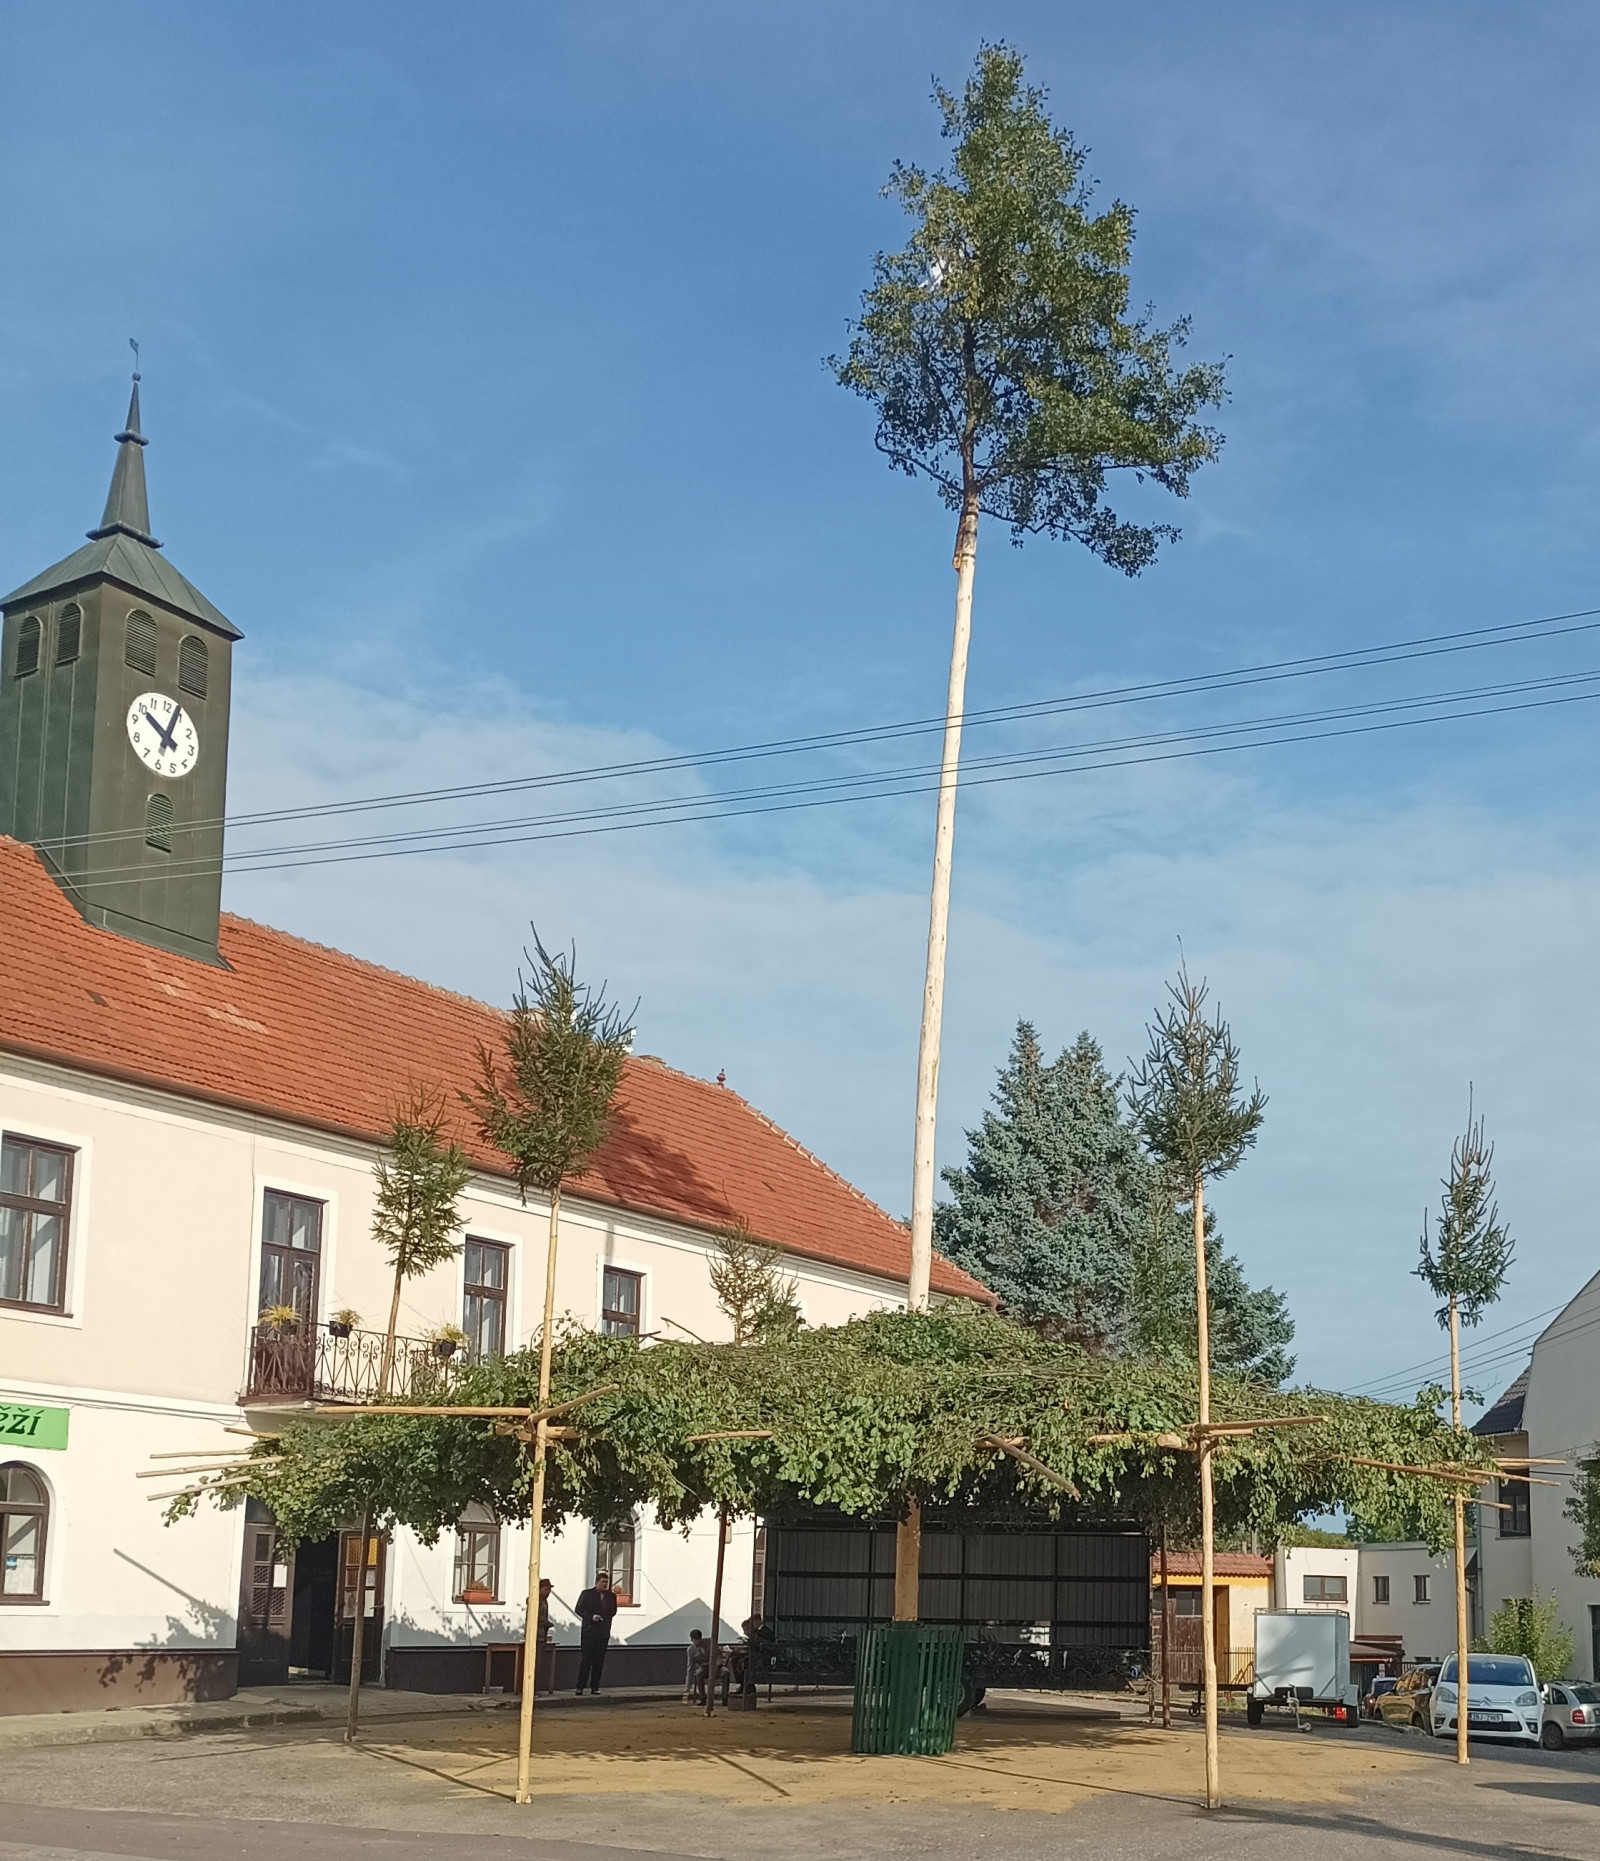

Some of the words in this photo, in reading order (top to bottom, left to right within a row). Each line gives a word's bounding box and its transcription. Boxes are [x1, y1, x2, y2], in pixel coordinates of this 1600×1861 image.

[138, 702, 148, 715] 10
[150, 697, 157, 710] 11
[163, 700, 172, 714] 12
[132, 714, 139, 724] 9
[178, 713, 182, 723] 1
[133, 732, 140, 743] 8
[185, 728, 193, 740] 2
[143, 747, 151, 758] 7
[187, 745, 195, 756] 3
[154, 759, 162, 770] 6
[169, 762, 177, 774] 5
[181, 759, 188, 769] 4
